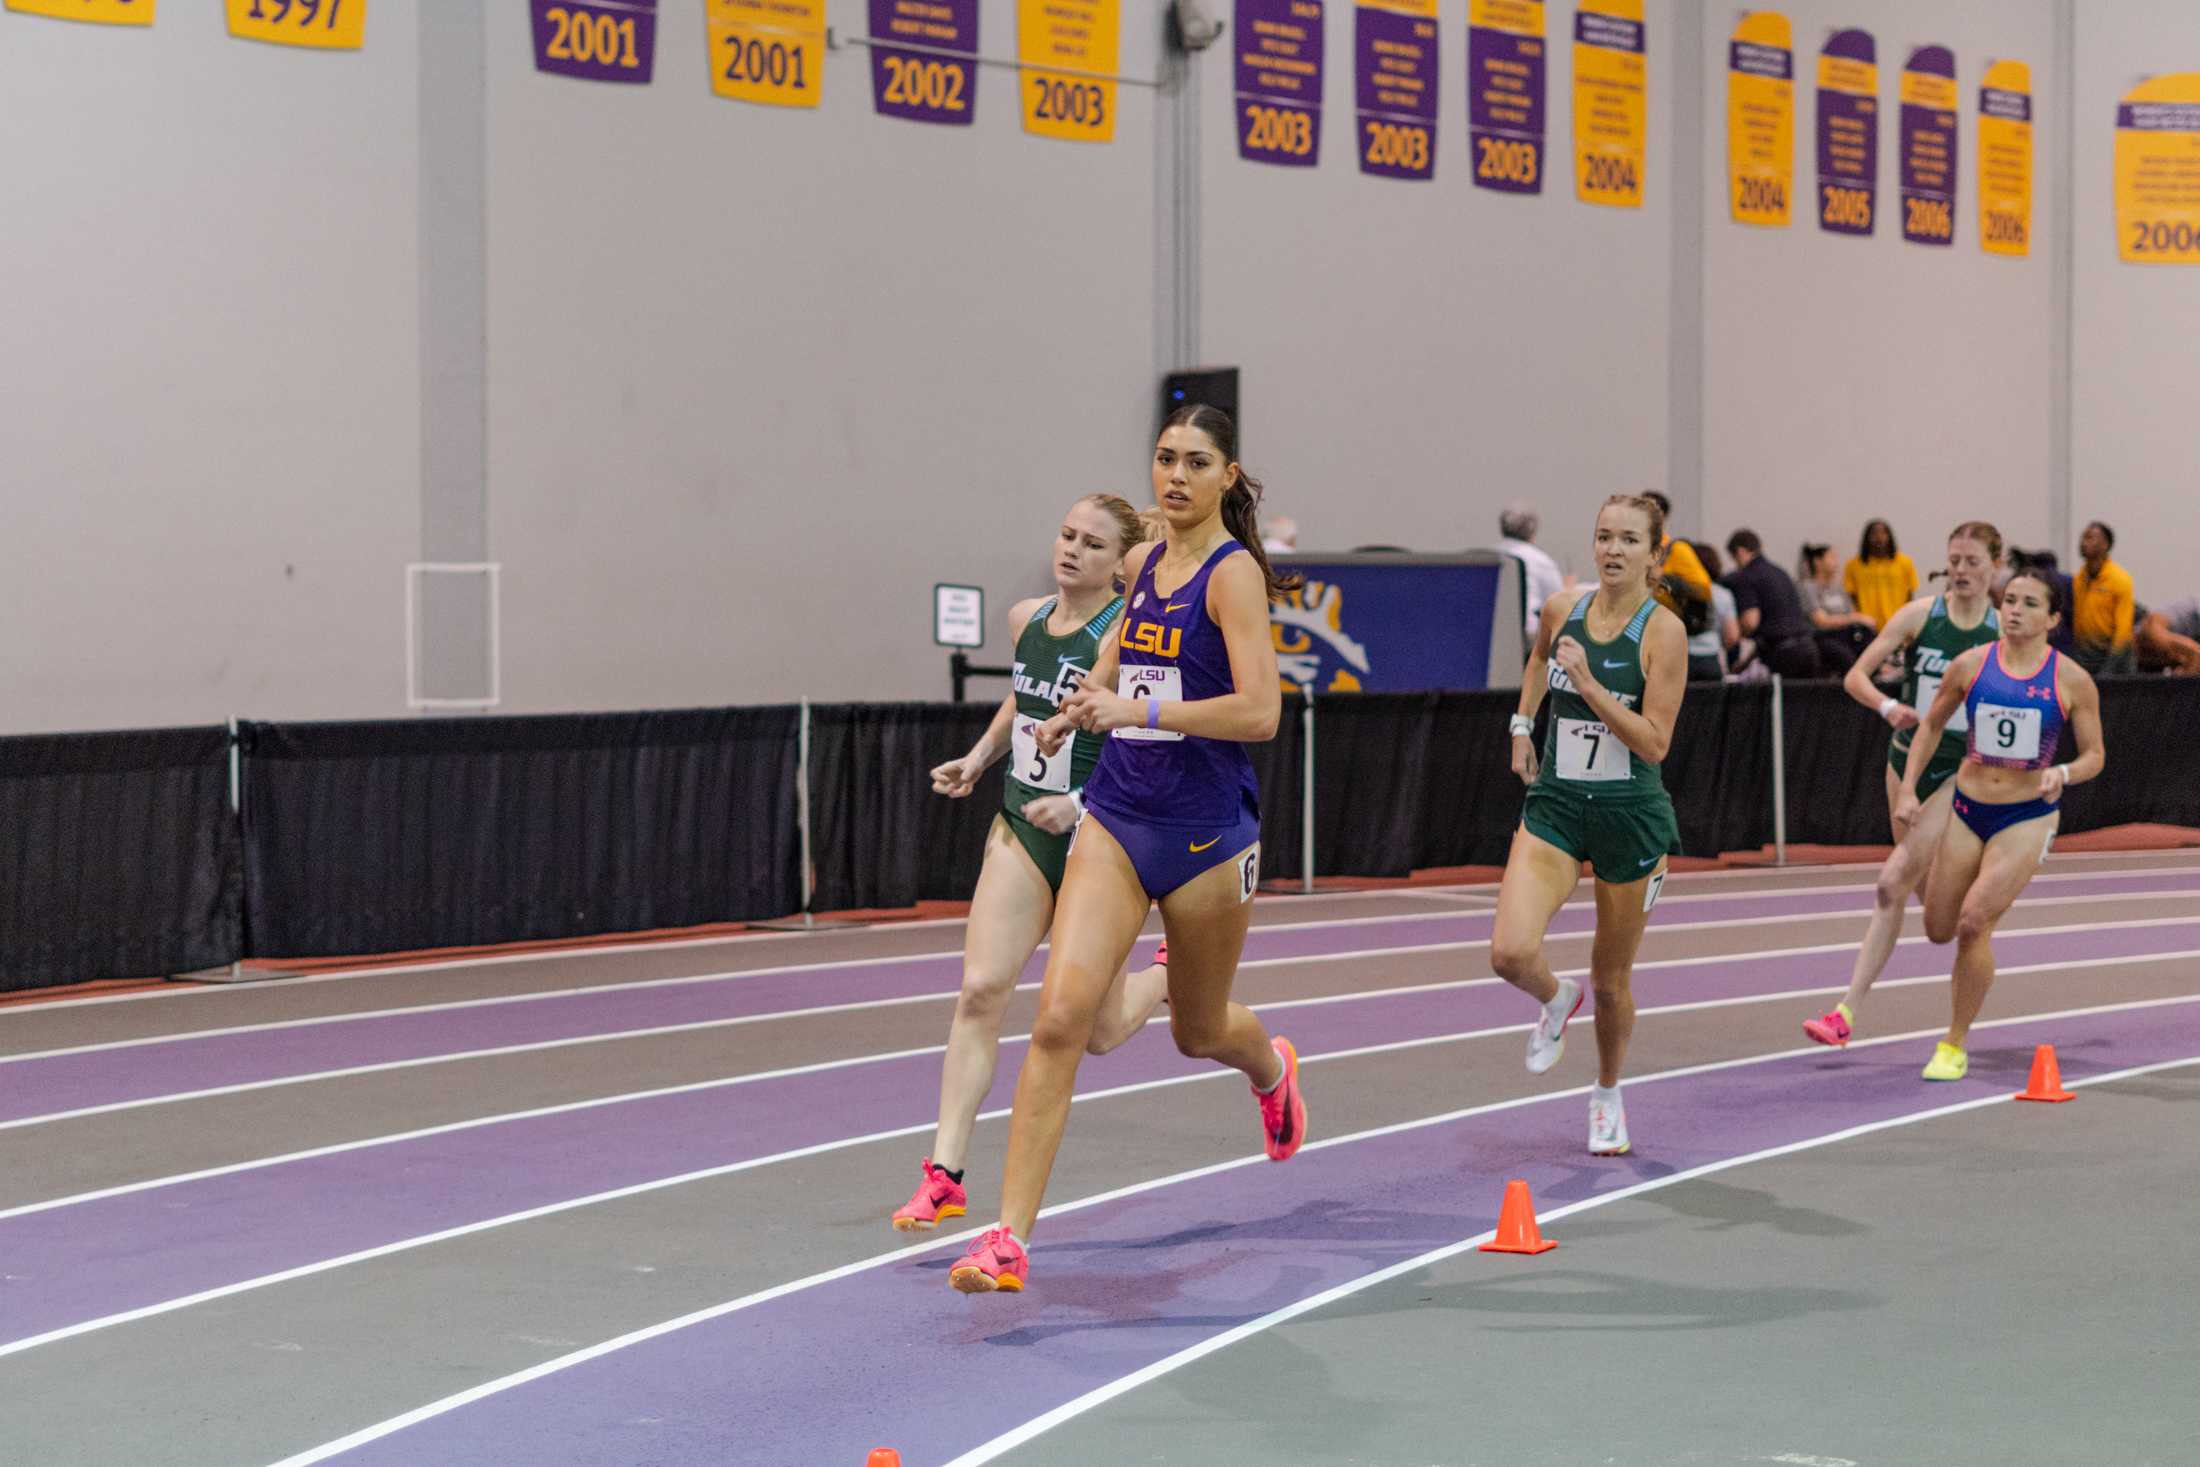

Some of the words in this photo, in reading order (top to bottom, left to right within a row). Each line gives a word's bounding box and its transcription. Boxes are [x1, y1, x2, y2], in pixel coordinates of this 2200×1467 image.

[546, 9, 638, 67] 2001
[724, 36, 806, 89] 2001
[883, 57, 965, 110] 2002
[1034, 79, 1105, 127] 2003
[1245, 106, 1313, 155] 2003
[1366, 122, 1428, 170] 2003
[1478, 138, 1537, 185] 2003
[1584, 154, 1638, 194] 2004
[1738, 174, 1785, 214] 2004
[1823, 185, 1870, 229] 2005
[1906, 197, 1951, 239] 2006
[1120, 618, 1182, 659] LSU
[1013, 662, 1060, 708] TULA
[1139, 669, 1165, 682] LSU
[1583, 734, 1600, 770] 7
[1997, 719, 2016, 748] 9
[1243, 853, 1256, 895] 6
[1651, 875, 1665, 907] 7
